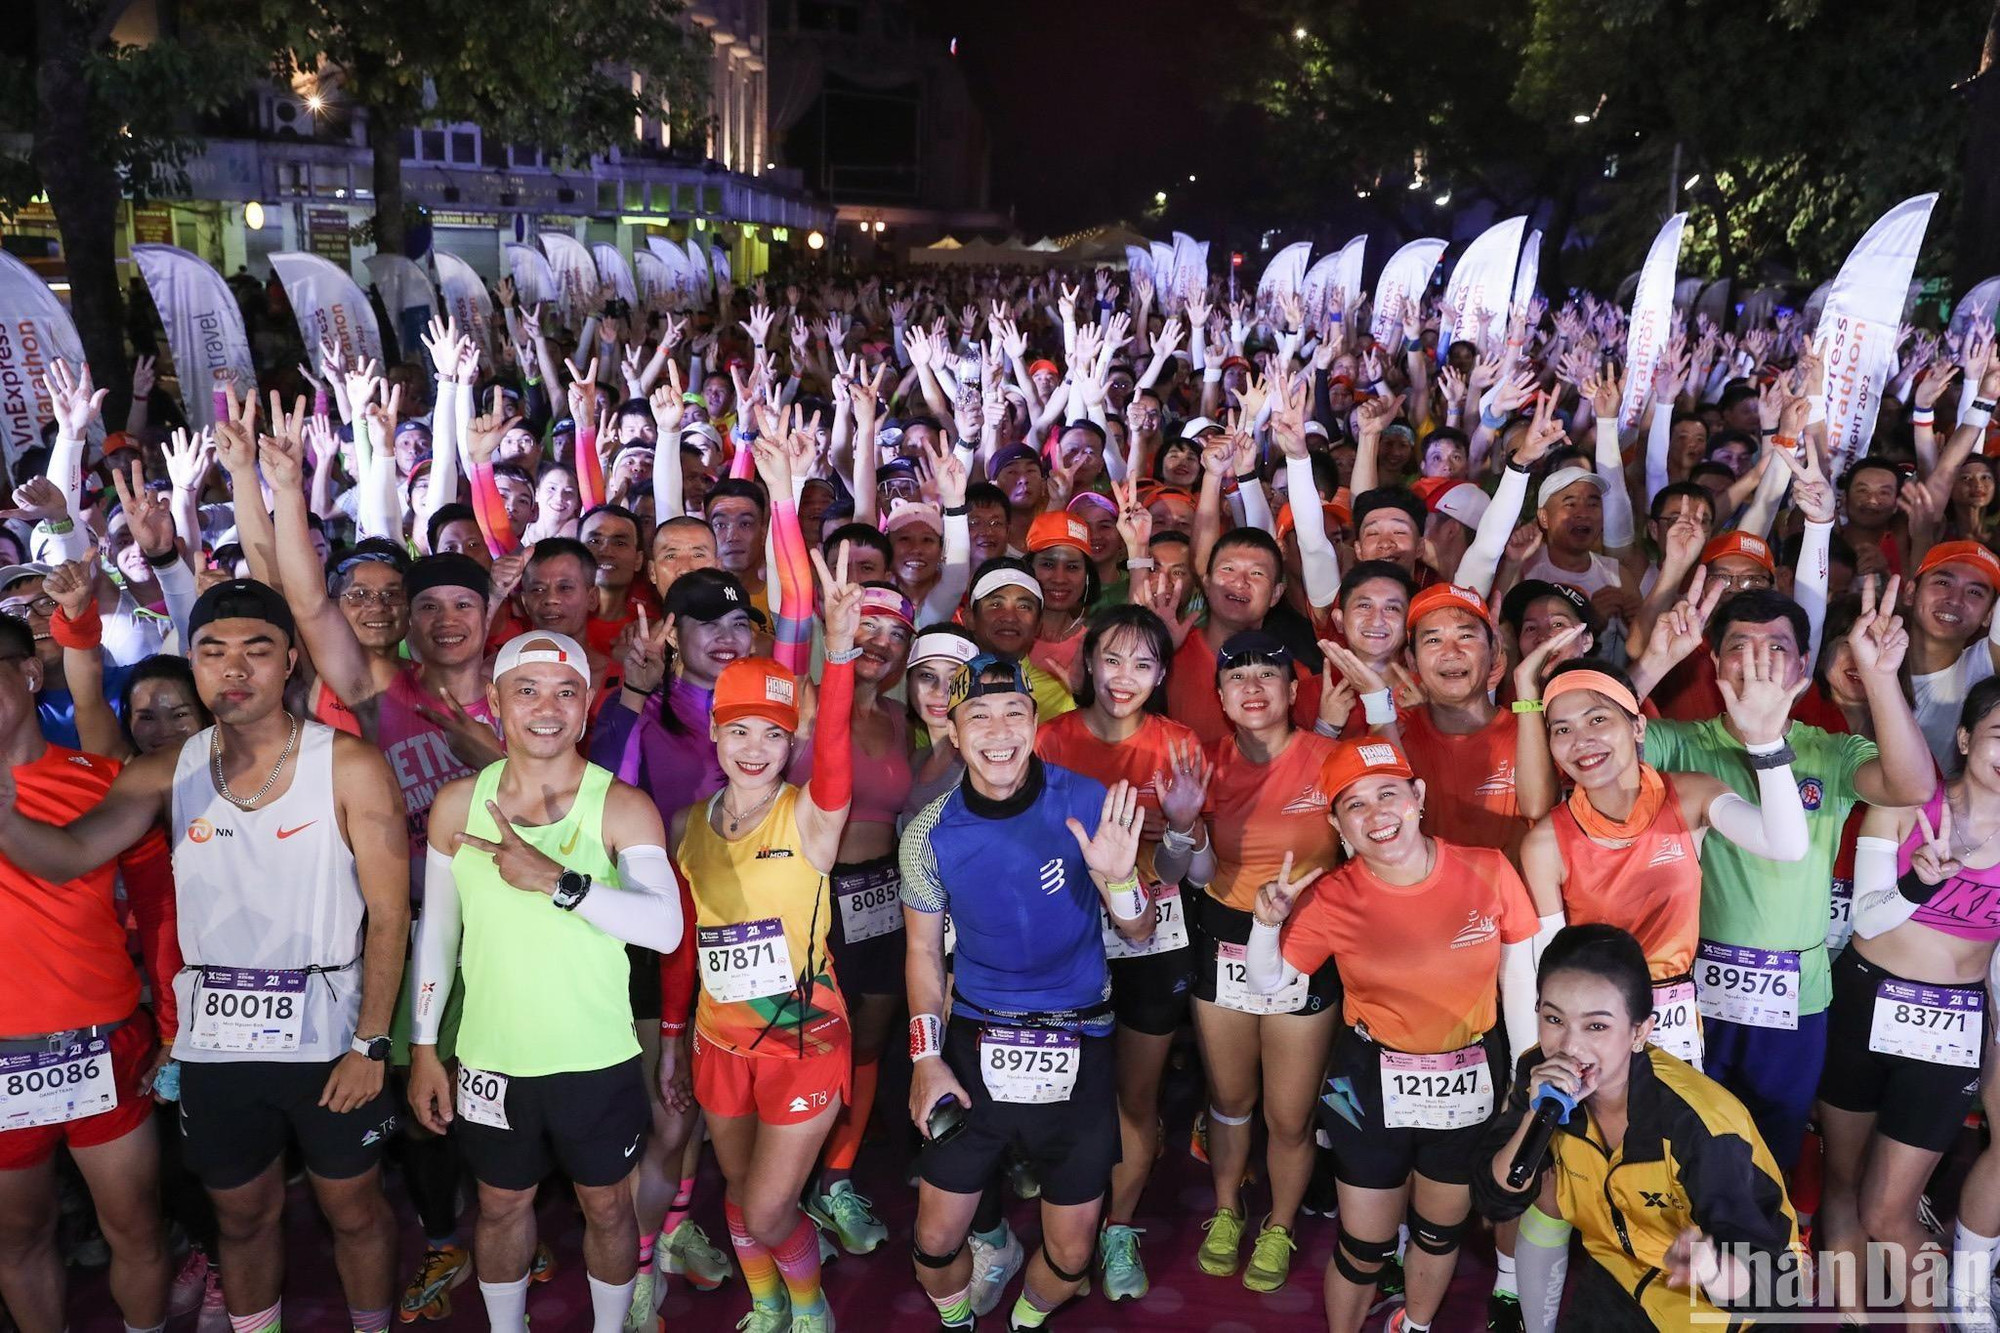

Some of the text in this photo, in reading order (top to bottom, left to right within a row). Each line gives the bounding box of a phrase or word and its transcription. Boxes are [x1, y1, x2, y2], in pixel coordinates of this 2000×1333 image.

[1857, 375, 1871, 411] 2022
[215, 828, 234, 837] NN
[708, 942, 775, 972] 87871
[1705, 965, 1788, 997] 89576
[205, 992, 293, 1019] 80018
[1894, 1004, 1966, 1032] 83771
[70, 1044, 83, 1057] 21
[990, 1048, 1069, 1074] 89752
[7, 1059, 100, 1096] 80086
[1393, 1070, 1477, 1097] 121247
[809, 1091, 828, 1108] T8
